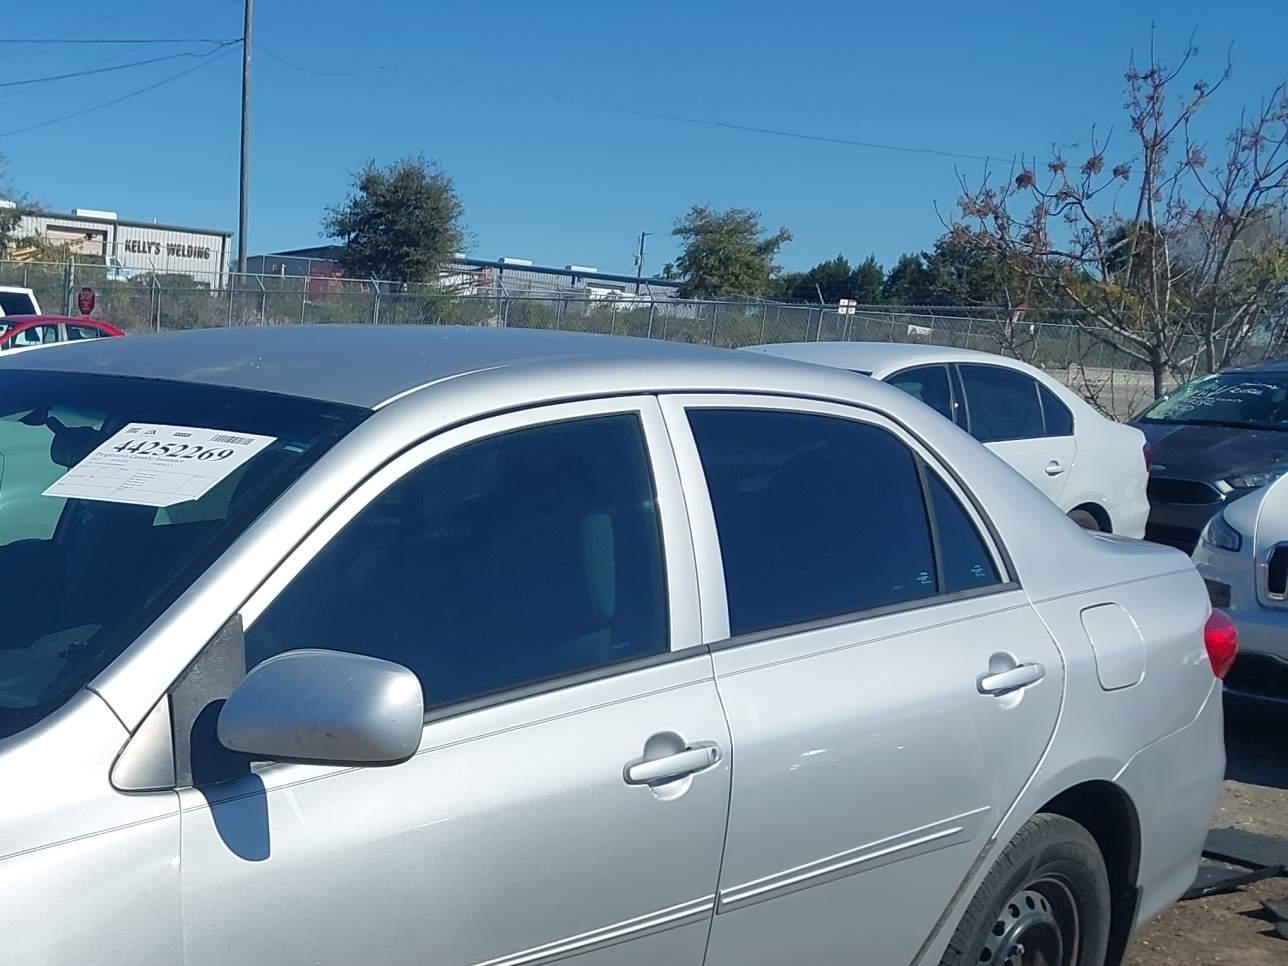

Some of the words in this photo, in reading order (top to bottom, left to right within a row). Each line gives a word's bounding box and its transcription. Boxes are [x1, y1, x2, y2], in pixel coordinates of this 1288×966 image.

[124, 239, 161, 255] KELLY'S
[166, 243, 211, 260] WELDING
[113, 440, 234, 462] 44252269
